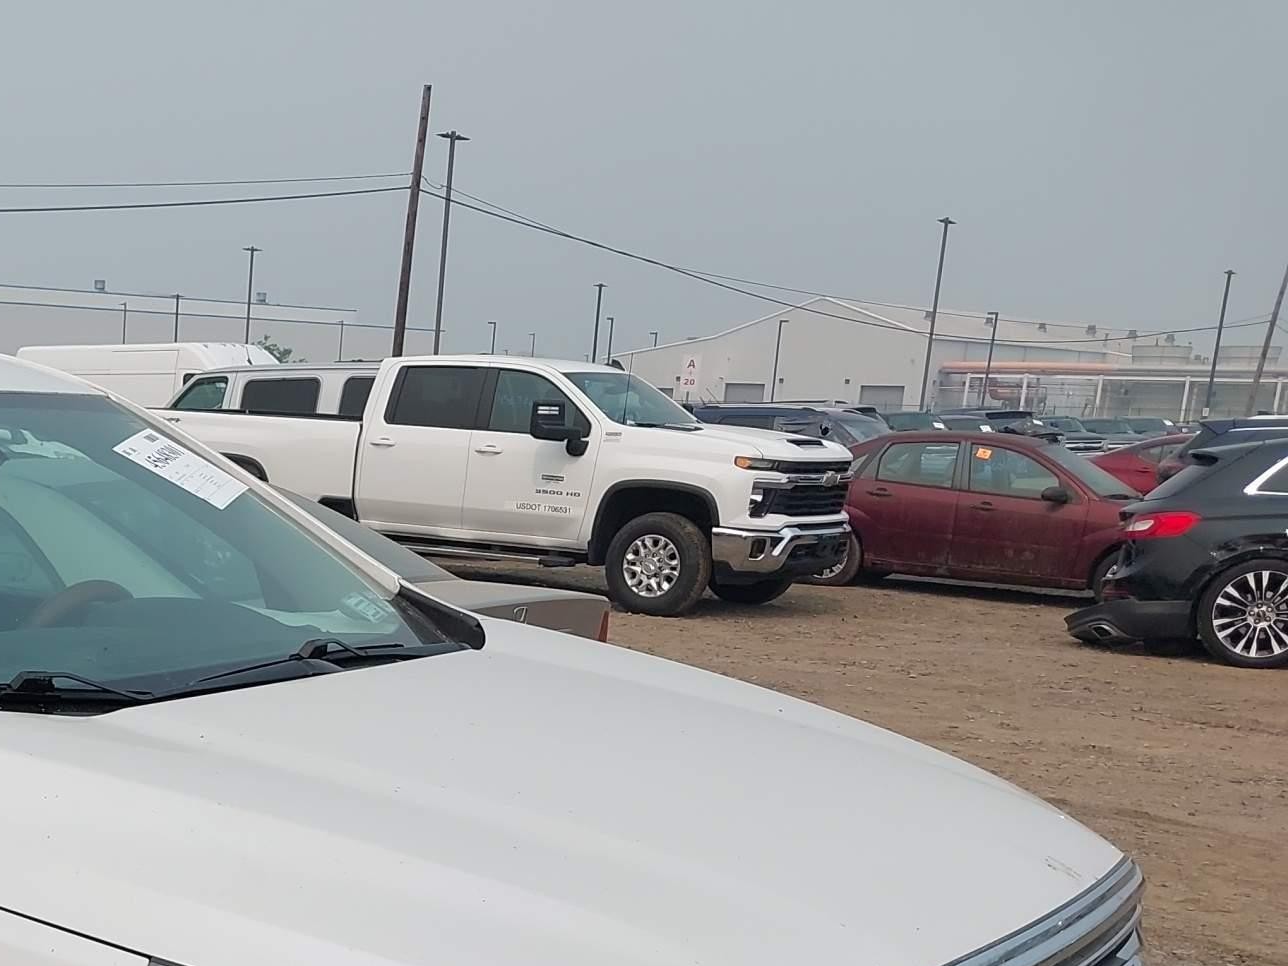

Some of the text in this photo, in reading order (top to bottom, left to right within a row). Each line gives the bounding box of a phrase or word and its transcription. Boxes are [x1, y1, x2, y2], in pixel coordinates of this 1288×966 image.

[687, 359, 695, 368] A
[683, 378, 696, 386] 20
[515, 502, 542, 512] USDOT
